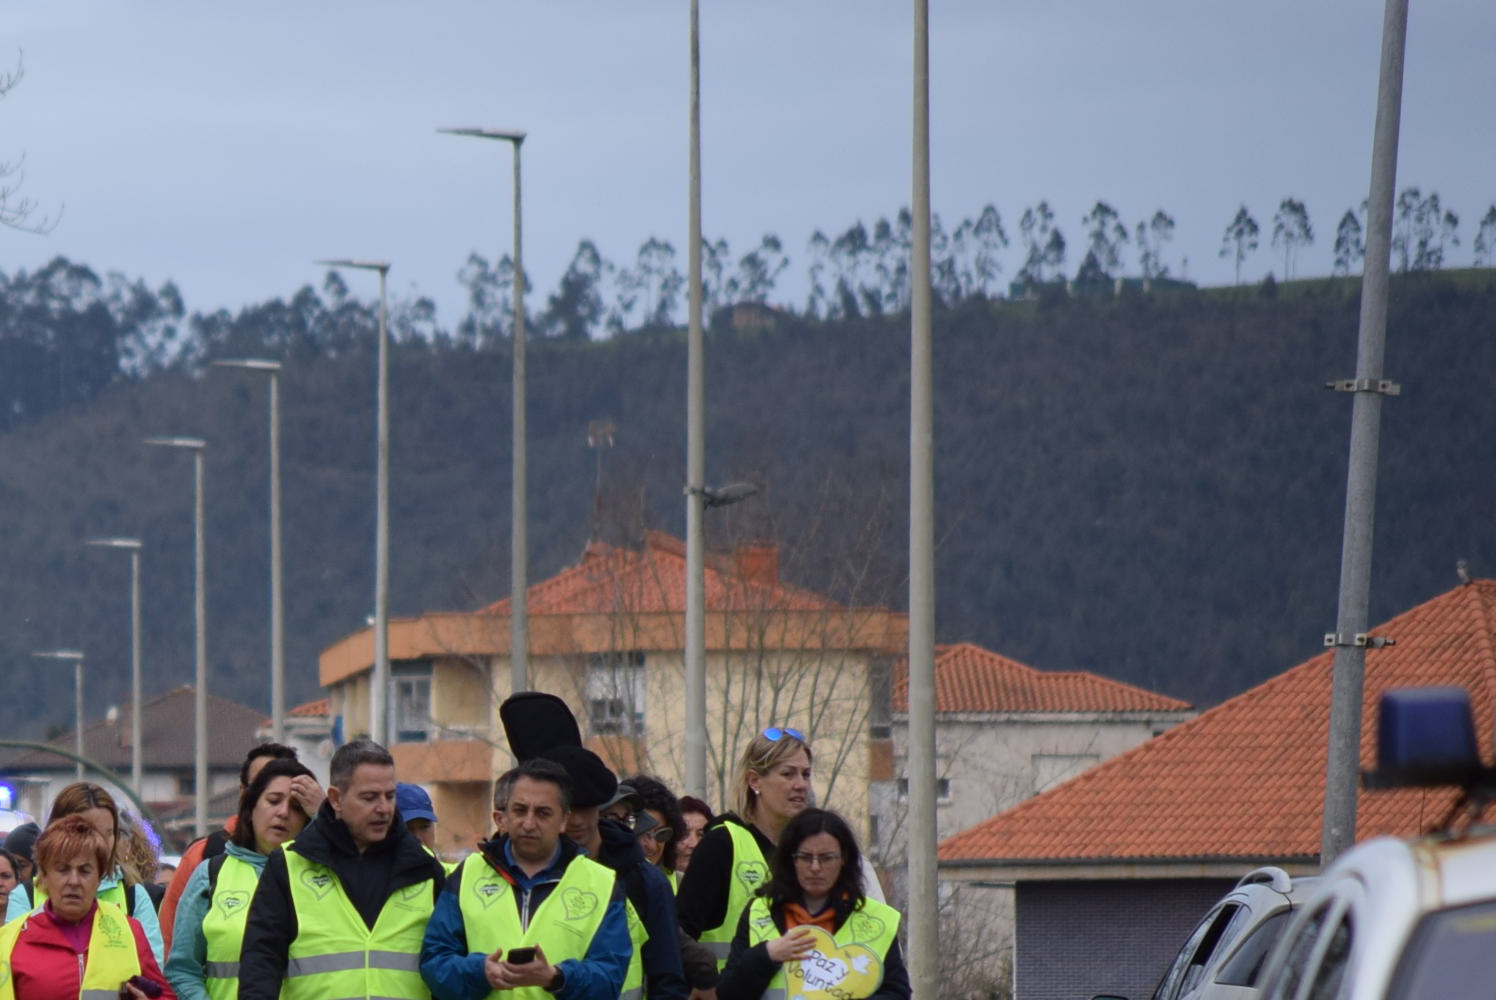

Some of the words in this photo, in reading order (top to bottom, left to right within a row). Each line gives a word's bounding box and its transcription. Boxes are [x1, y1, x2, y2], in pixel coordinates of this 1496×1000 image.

[788, 961, 854, 1000] Voluntad
[809, 950, 836, 973] Paz
[836, 968, 850, 981] y
